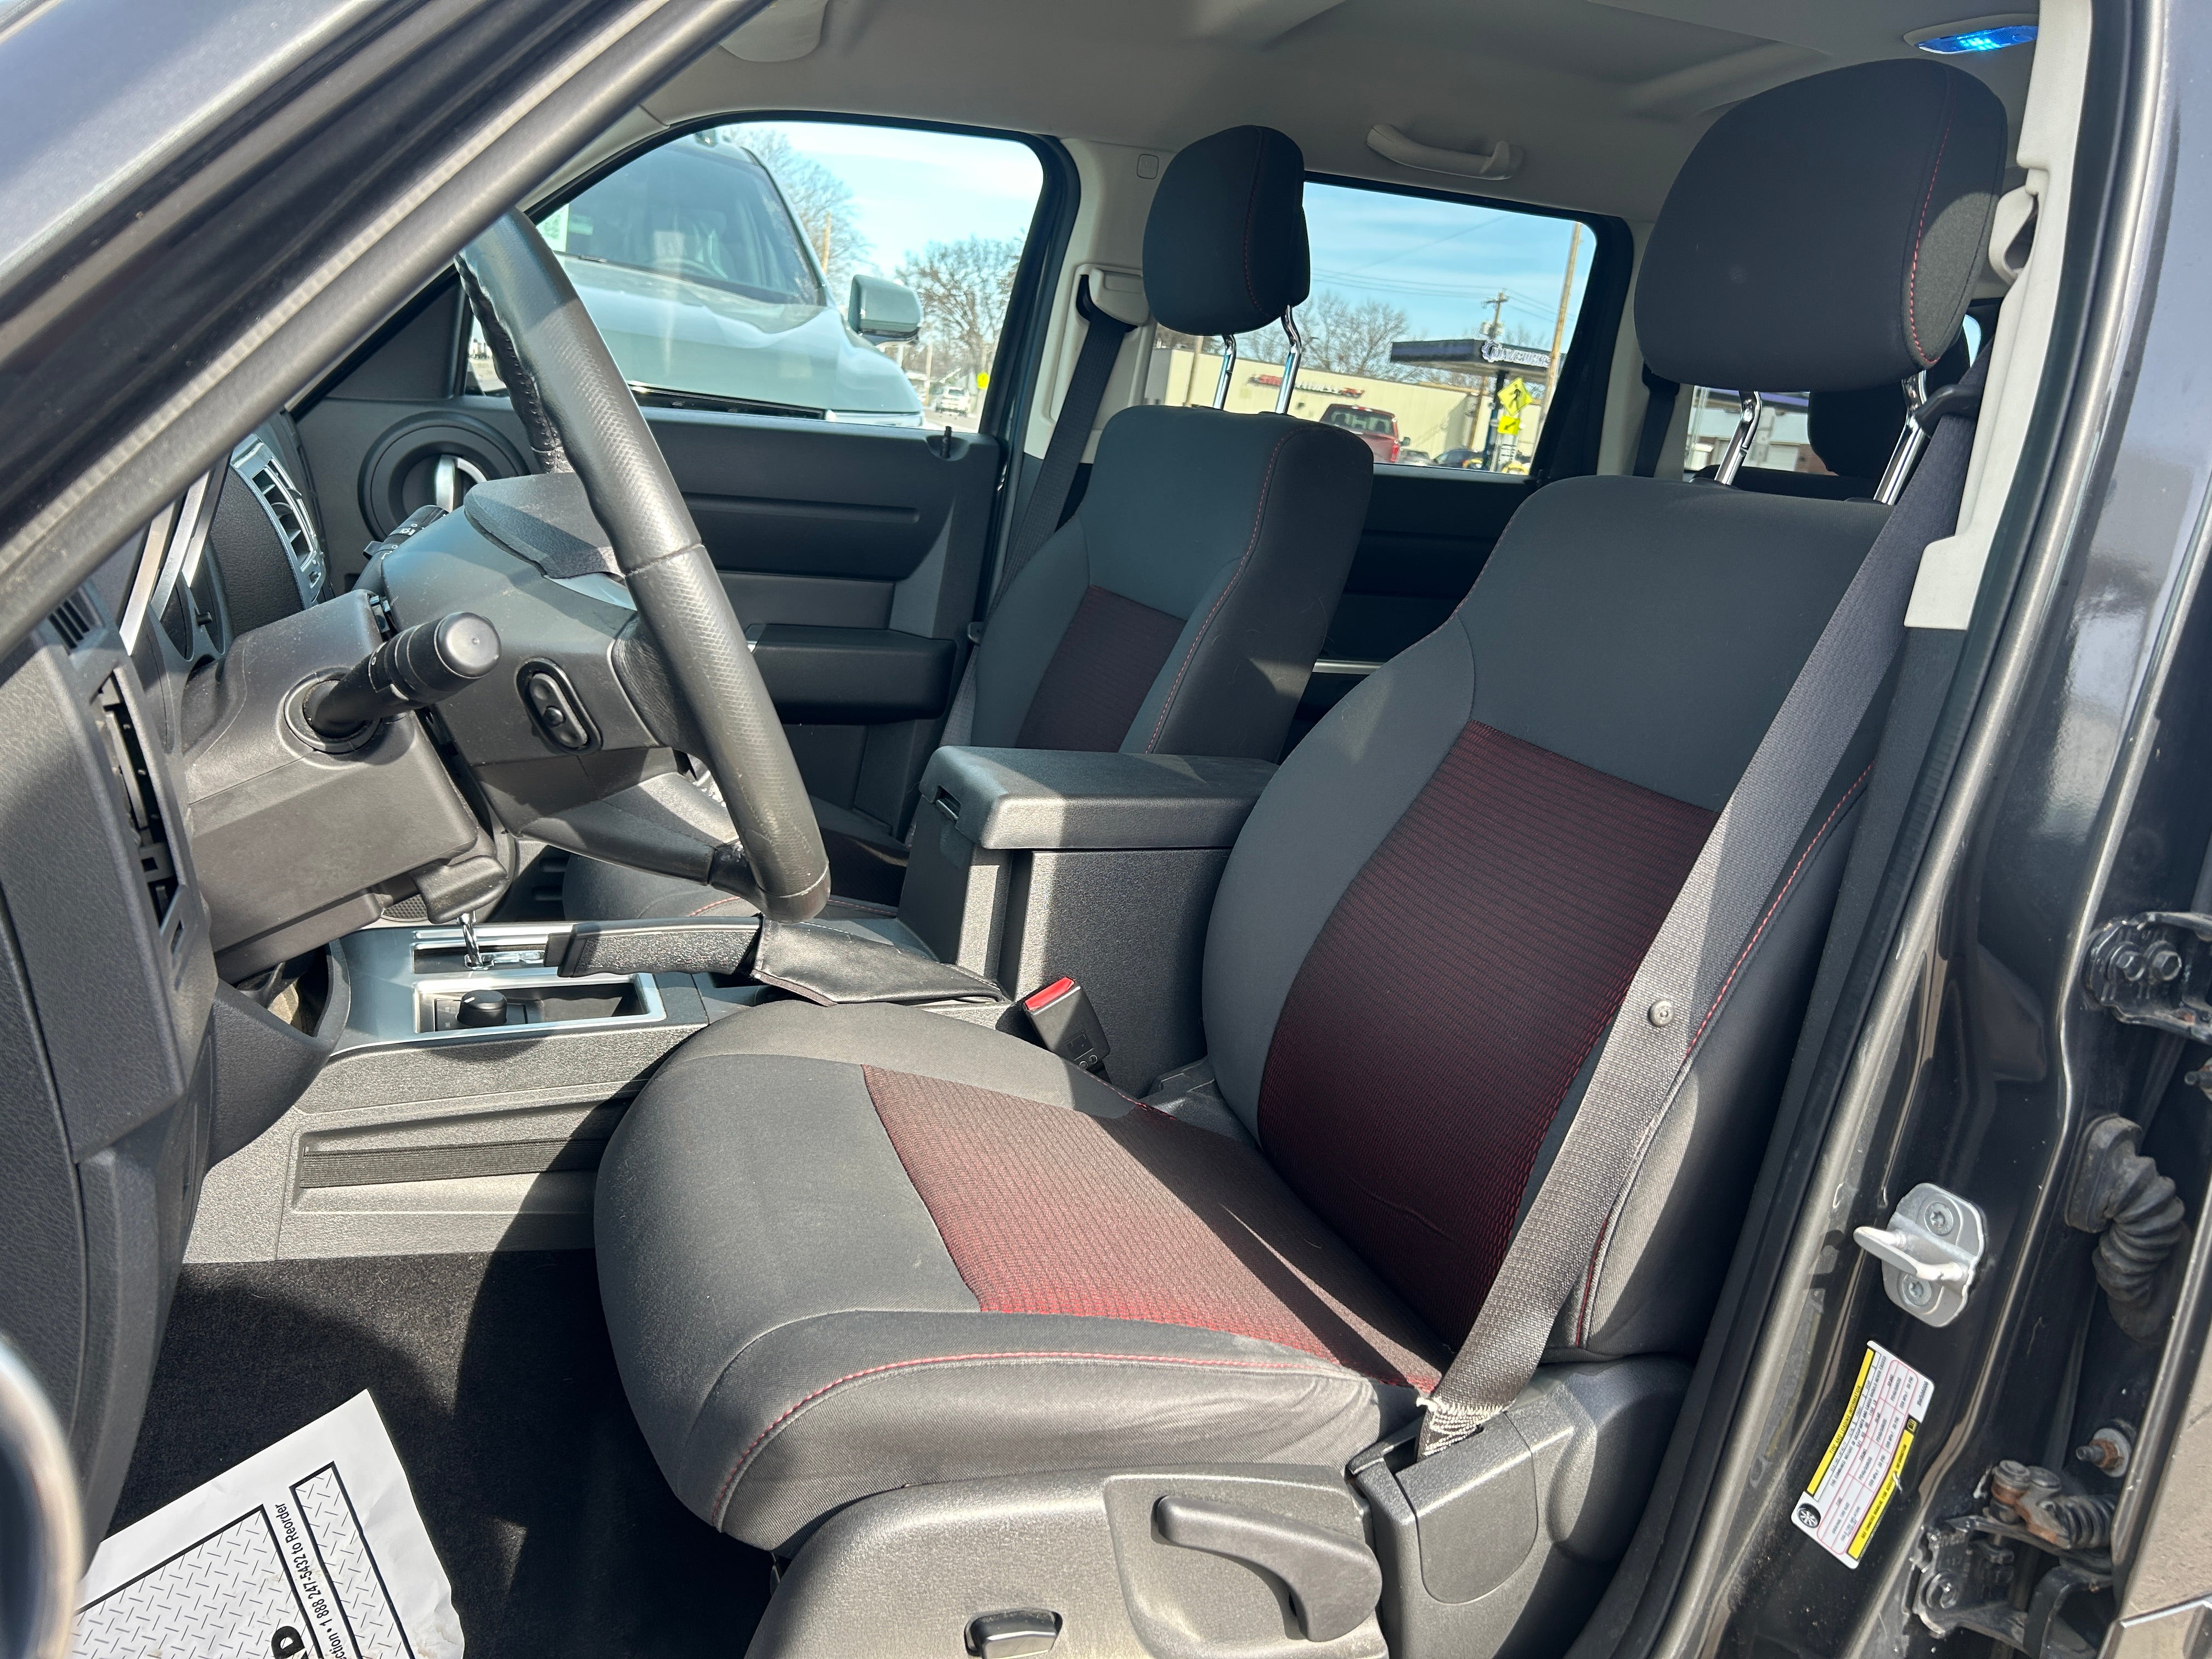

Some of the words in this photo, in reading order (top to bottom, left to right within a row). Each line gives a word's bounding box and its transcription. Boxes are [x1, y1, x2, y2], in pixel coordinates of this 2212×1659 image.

[1840, 1415, 1850, 1434] LOADING
[1849, 1385, 1861, 1415] INFORMATION
[275, 1503, 298, 1543] Reorder
[291, 1542, 303, 1554] to
[294, 1554, 321, 1599] 247-5432
[312, 1599, 330, 1619] 888
[319, 1618, 332, 1627] 1
[329, 1633, 347, 1659] ction
